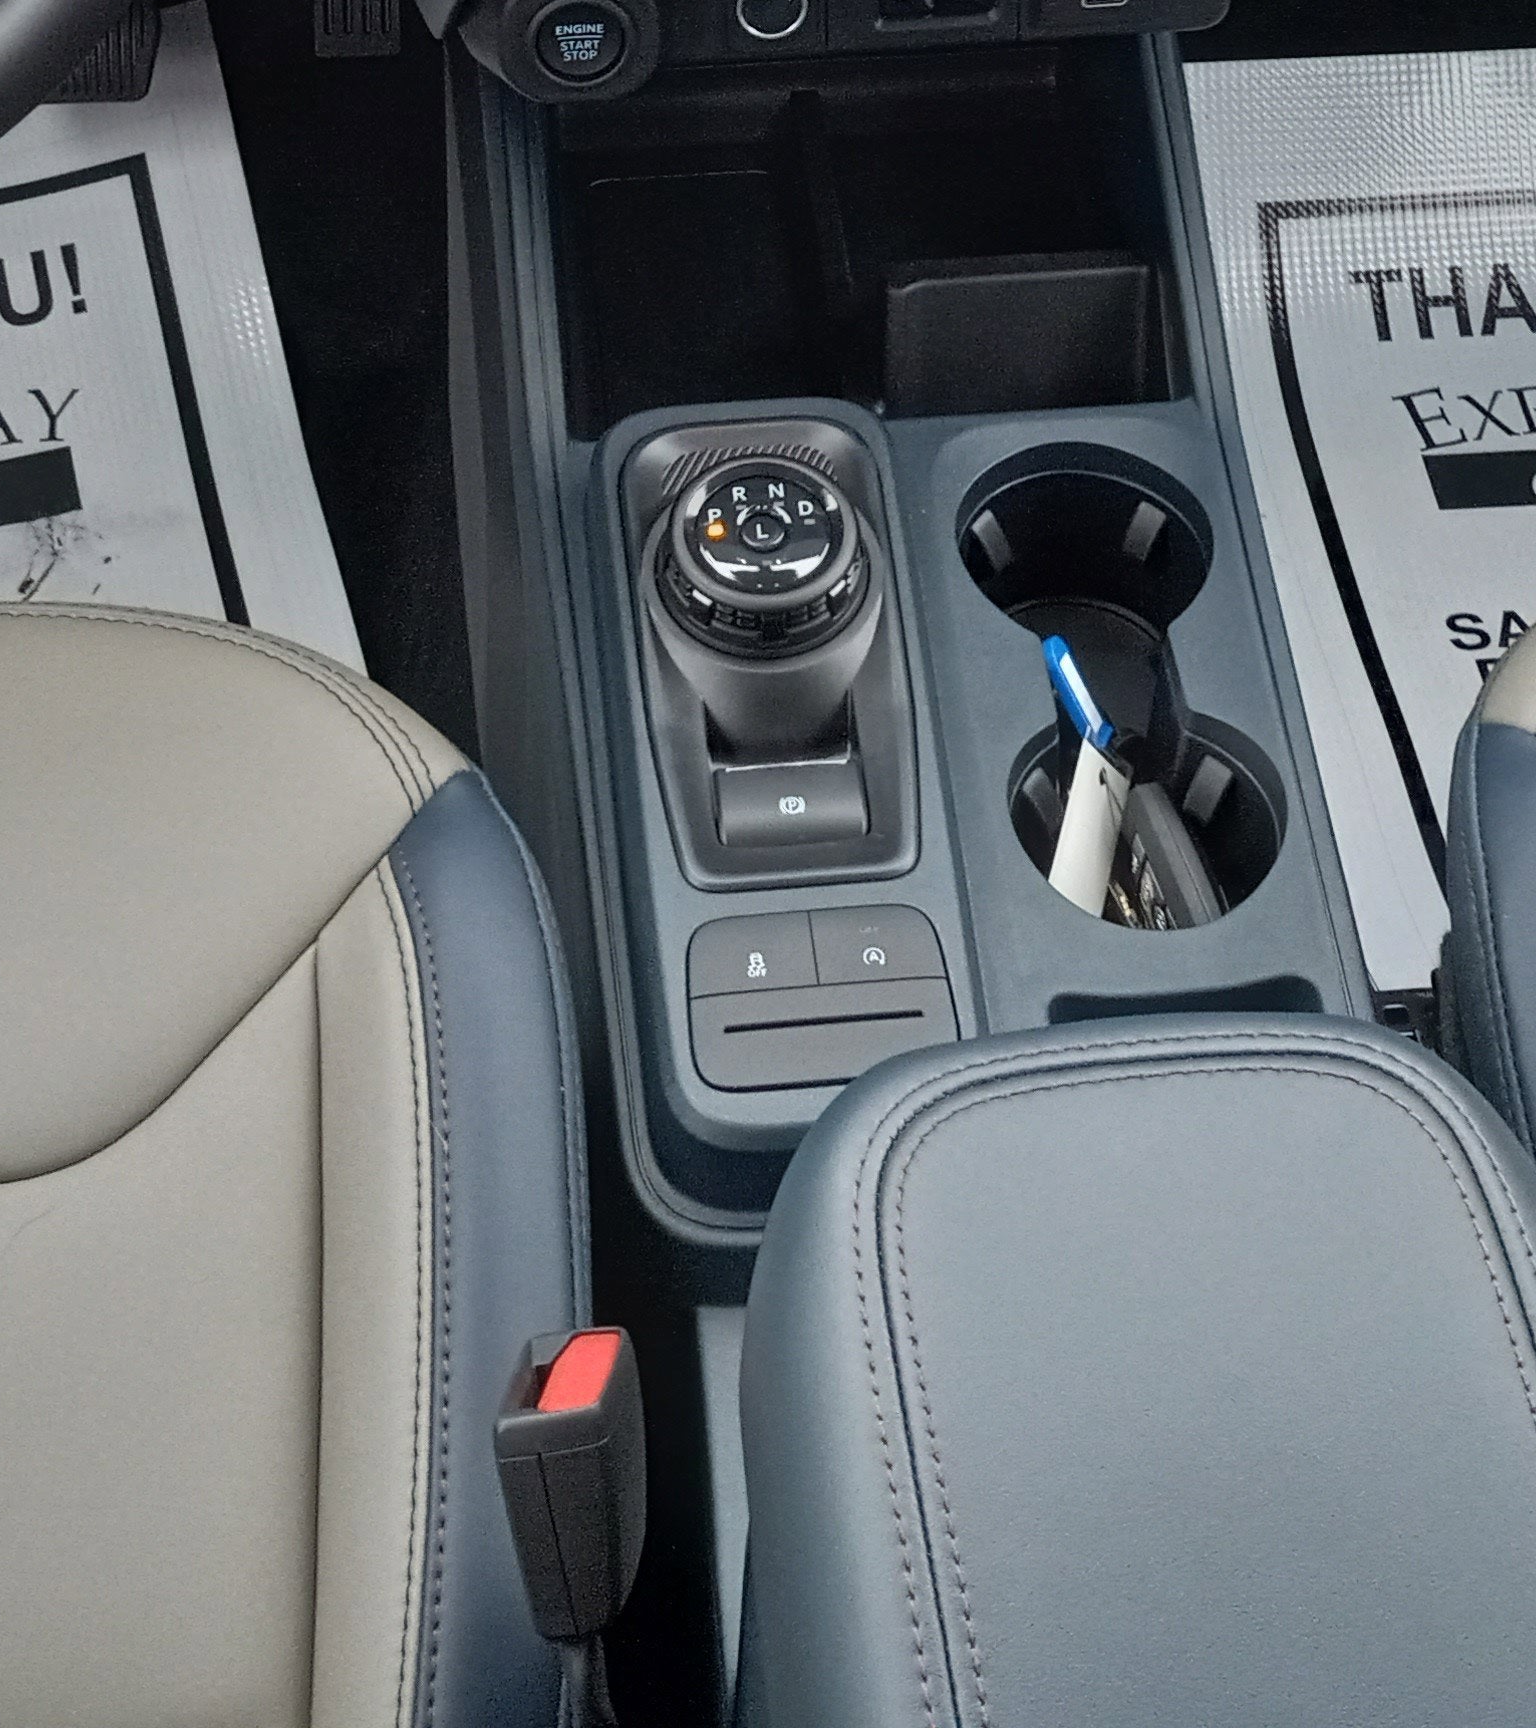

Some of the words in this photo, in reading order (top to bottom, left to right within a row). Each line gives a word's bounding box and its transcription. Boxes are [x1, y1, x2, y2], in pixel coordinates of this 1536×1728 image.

[555, 23, 606, 36] ENGINE
[559, 39, 600, 52] START
[562, 49, 598, 62] STOP
[732, 486, 748, 502] R
[768, 483, 785, 498] N
[708, 508, 722, 523] P
[797, 500, 814, 516] D
[756, 524, 769, 539] L
